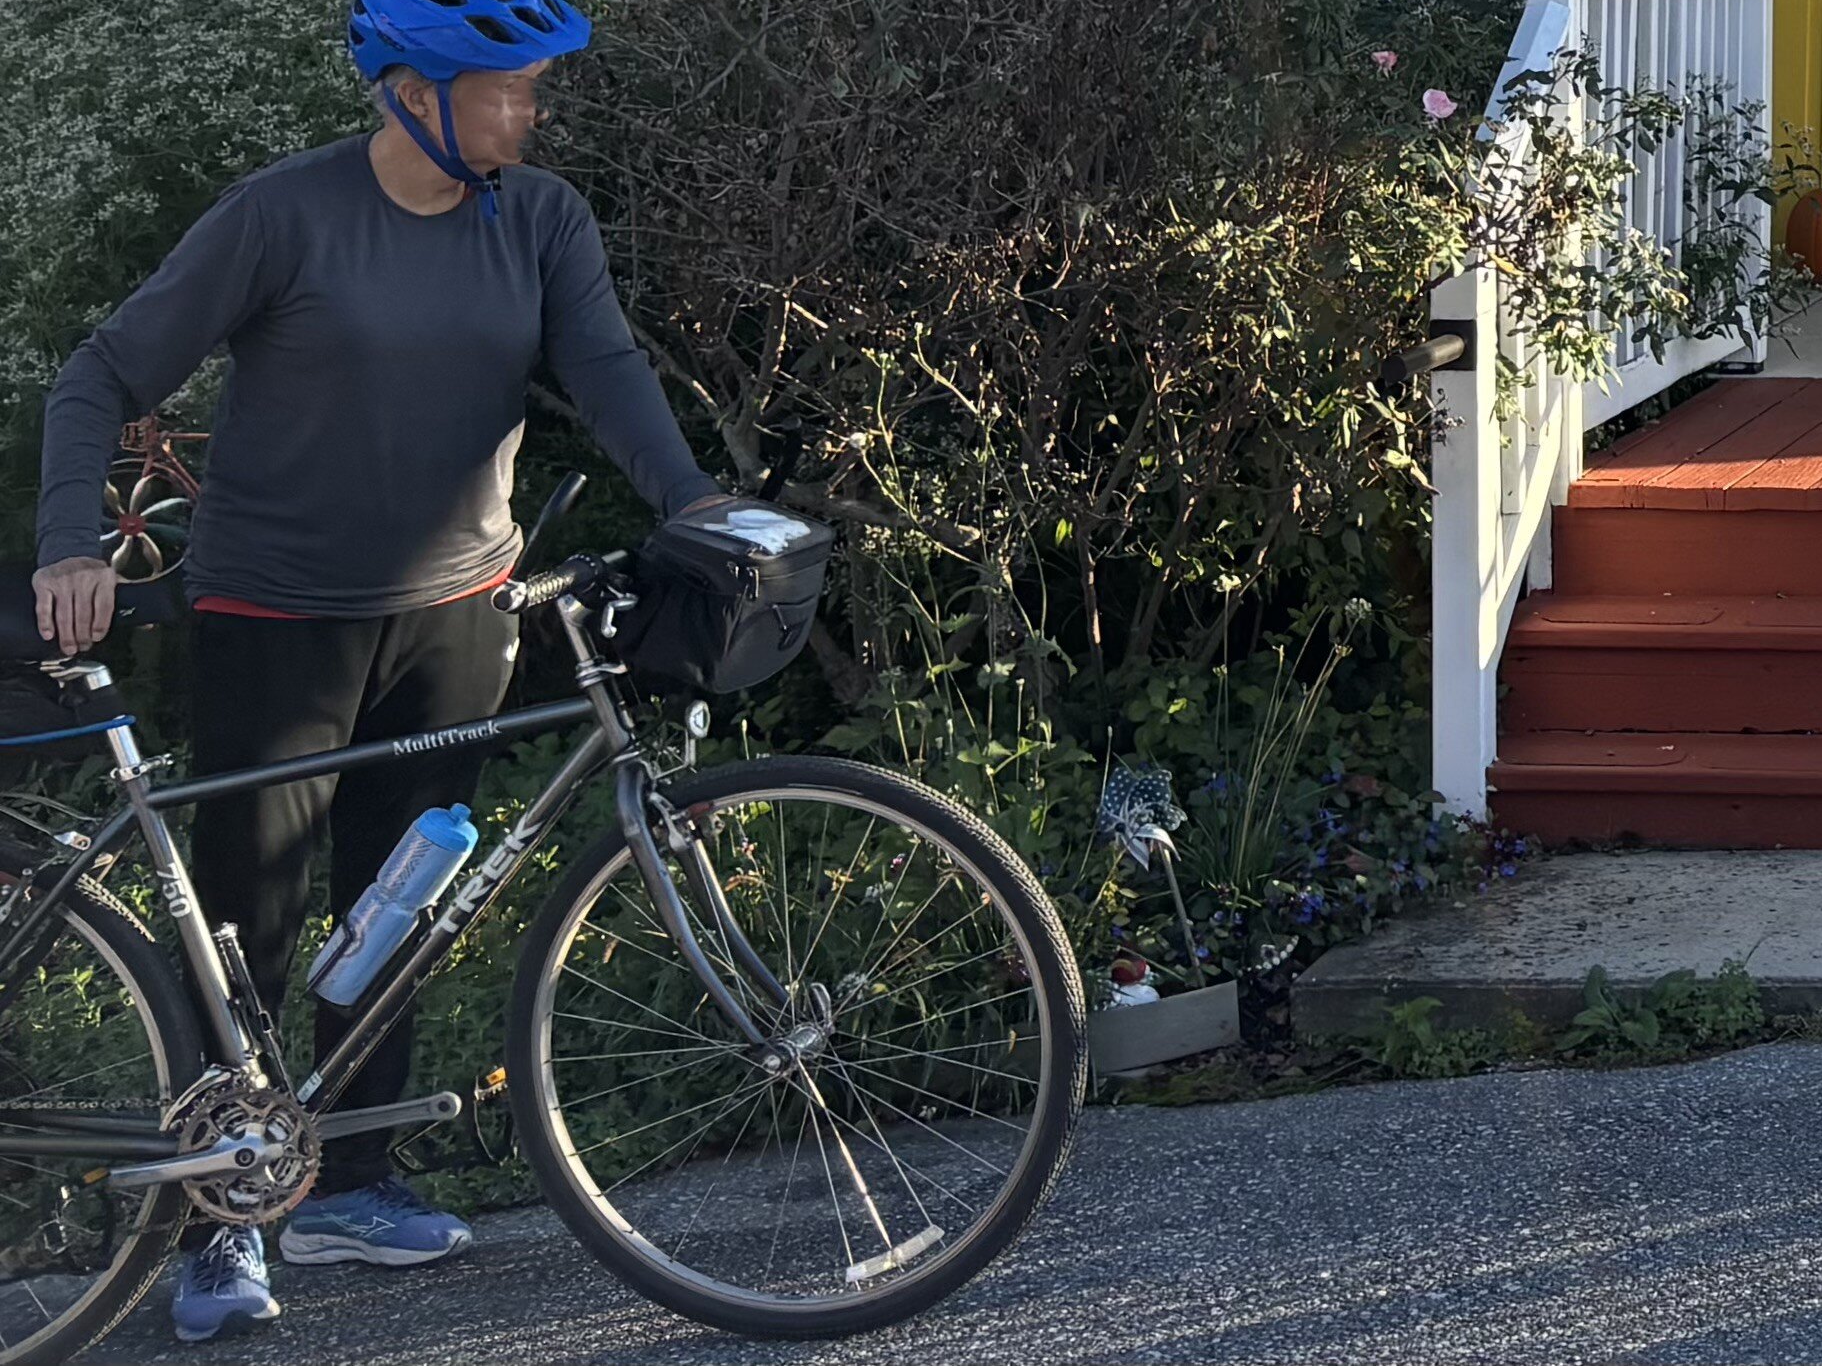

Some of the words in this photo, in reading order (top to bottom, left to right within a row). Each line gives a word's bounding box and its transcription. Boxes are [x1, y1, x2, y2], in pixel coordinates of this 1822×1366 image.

[392, 719, 502, 756] MultiTrack
[155, 861, 192, 918] 750
[430, 811, 547, 935] TREK
